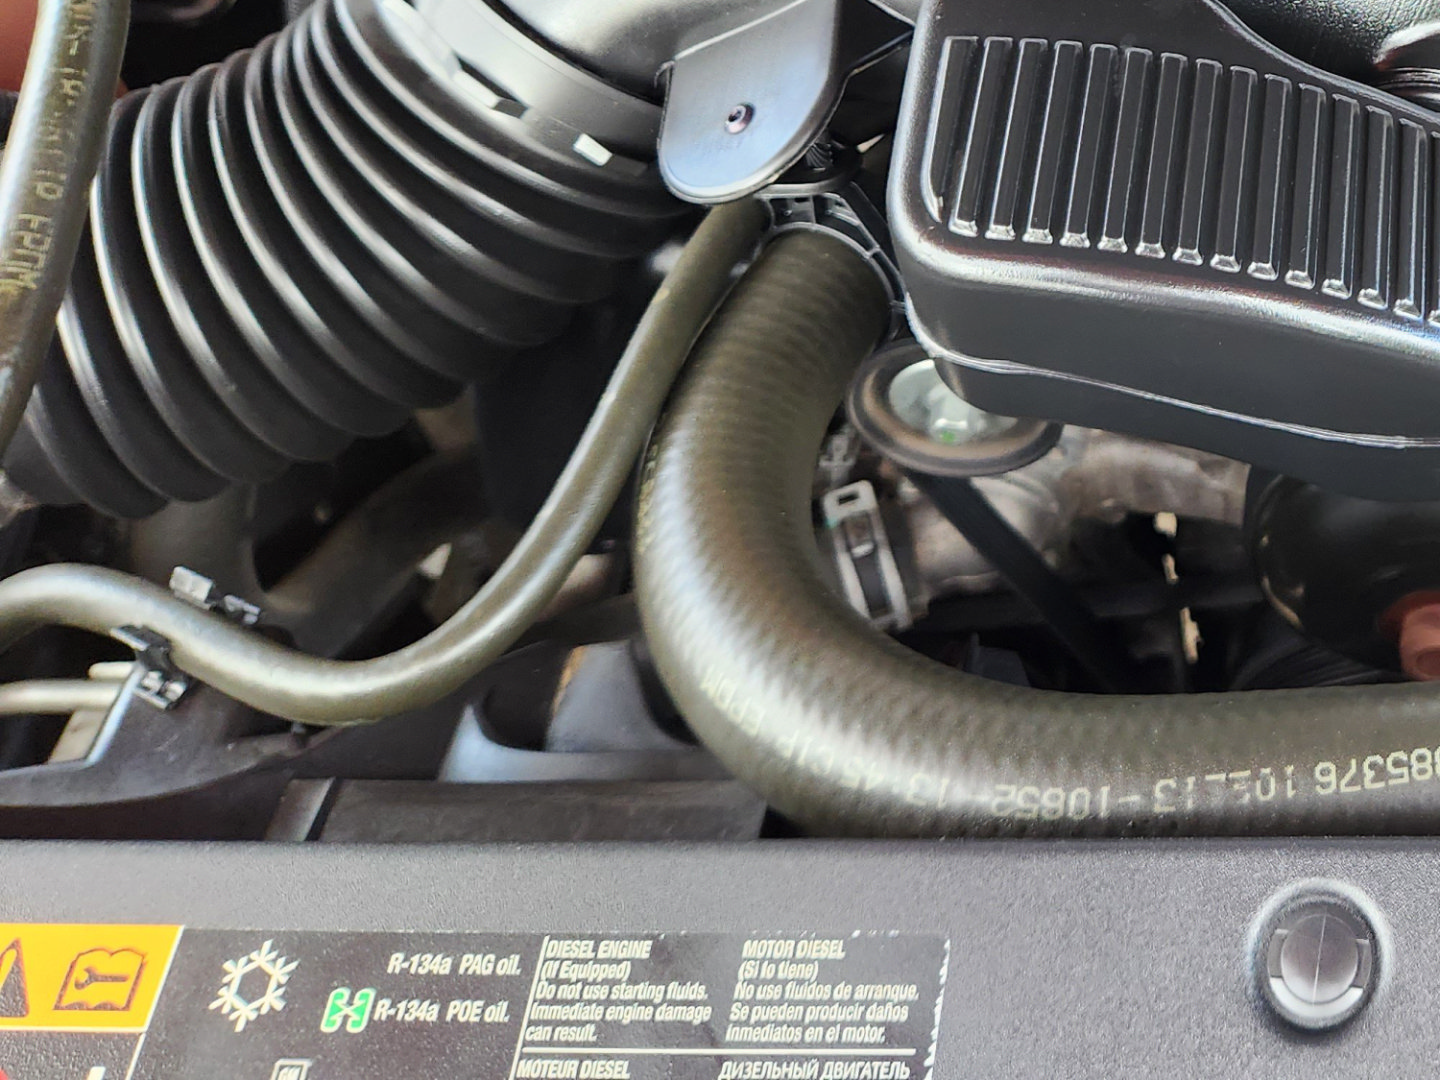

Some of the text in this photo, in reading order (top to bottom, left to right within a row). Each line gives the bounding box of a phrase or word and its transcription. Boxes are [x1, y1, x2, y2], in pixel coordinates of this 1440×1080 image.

[546, 939, 653, 959] DIESEL ENGINE
[741, 939, 846, 959] MOTOR DIESEL
[387, 952, 522, 976] R-134a PAG oil.
[540, 960, 632, 982] (If Equipped)
[738, 960, 759, 981] (Si
[776, 960, 819, 983] tiene)
[536, 980, 709, 1004] Do not use starting fluids.
[733, 981, 920, 1004] No use fluidos de arranque.
[373, 997, 510, 1023] R-134a POE oil.
[530, 1001, 713, 1025] Immediate engine damage
[729, 1001, 909, 1024] Se pueden producir daños
[525, 1023, 598, 1042] can result.
[803, 1027, 824, 1043] en
[824, 1024, 841, 1043] el
[841, 1025, 887, 1044] motor.
[515, 1059, 631, 1079] MOTEUR DIESEL
[718, 1059, 911, 1080] ДИЗЕЛЬНЫЙ ДВИГАТЕЛЬ
